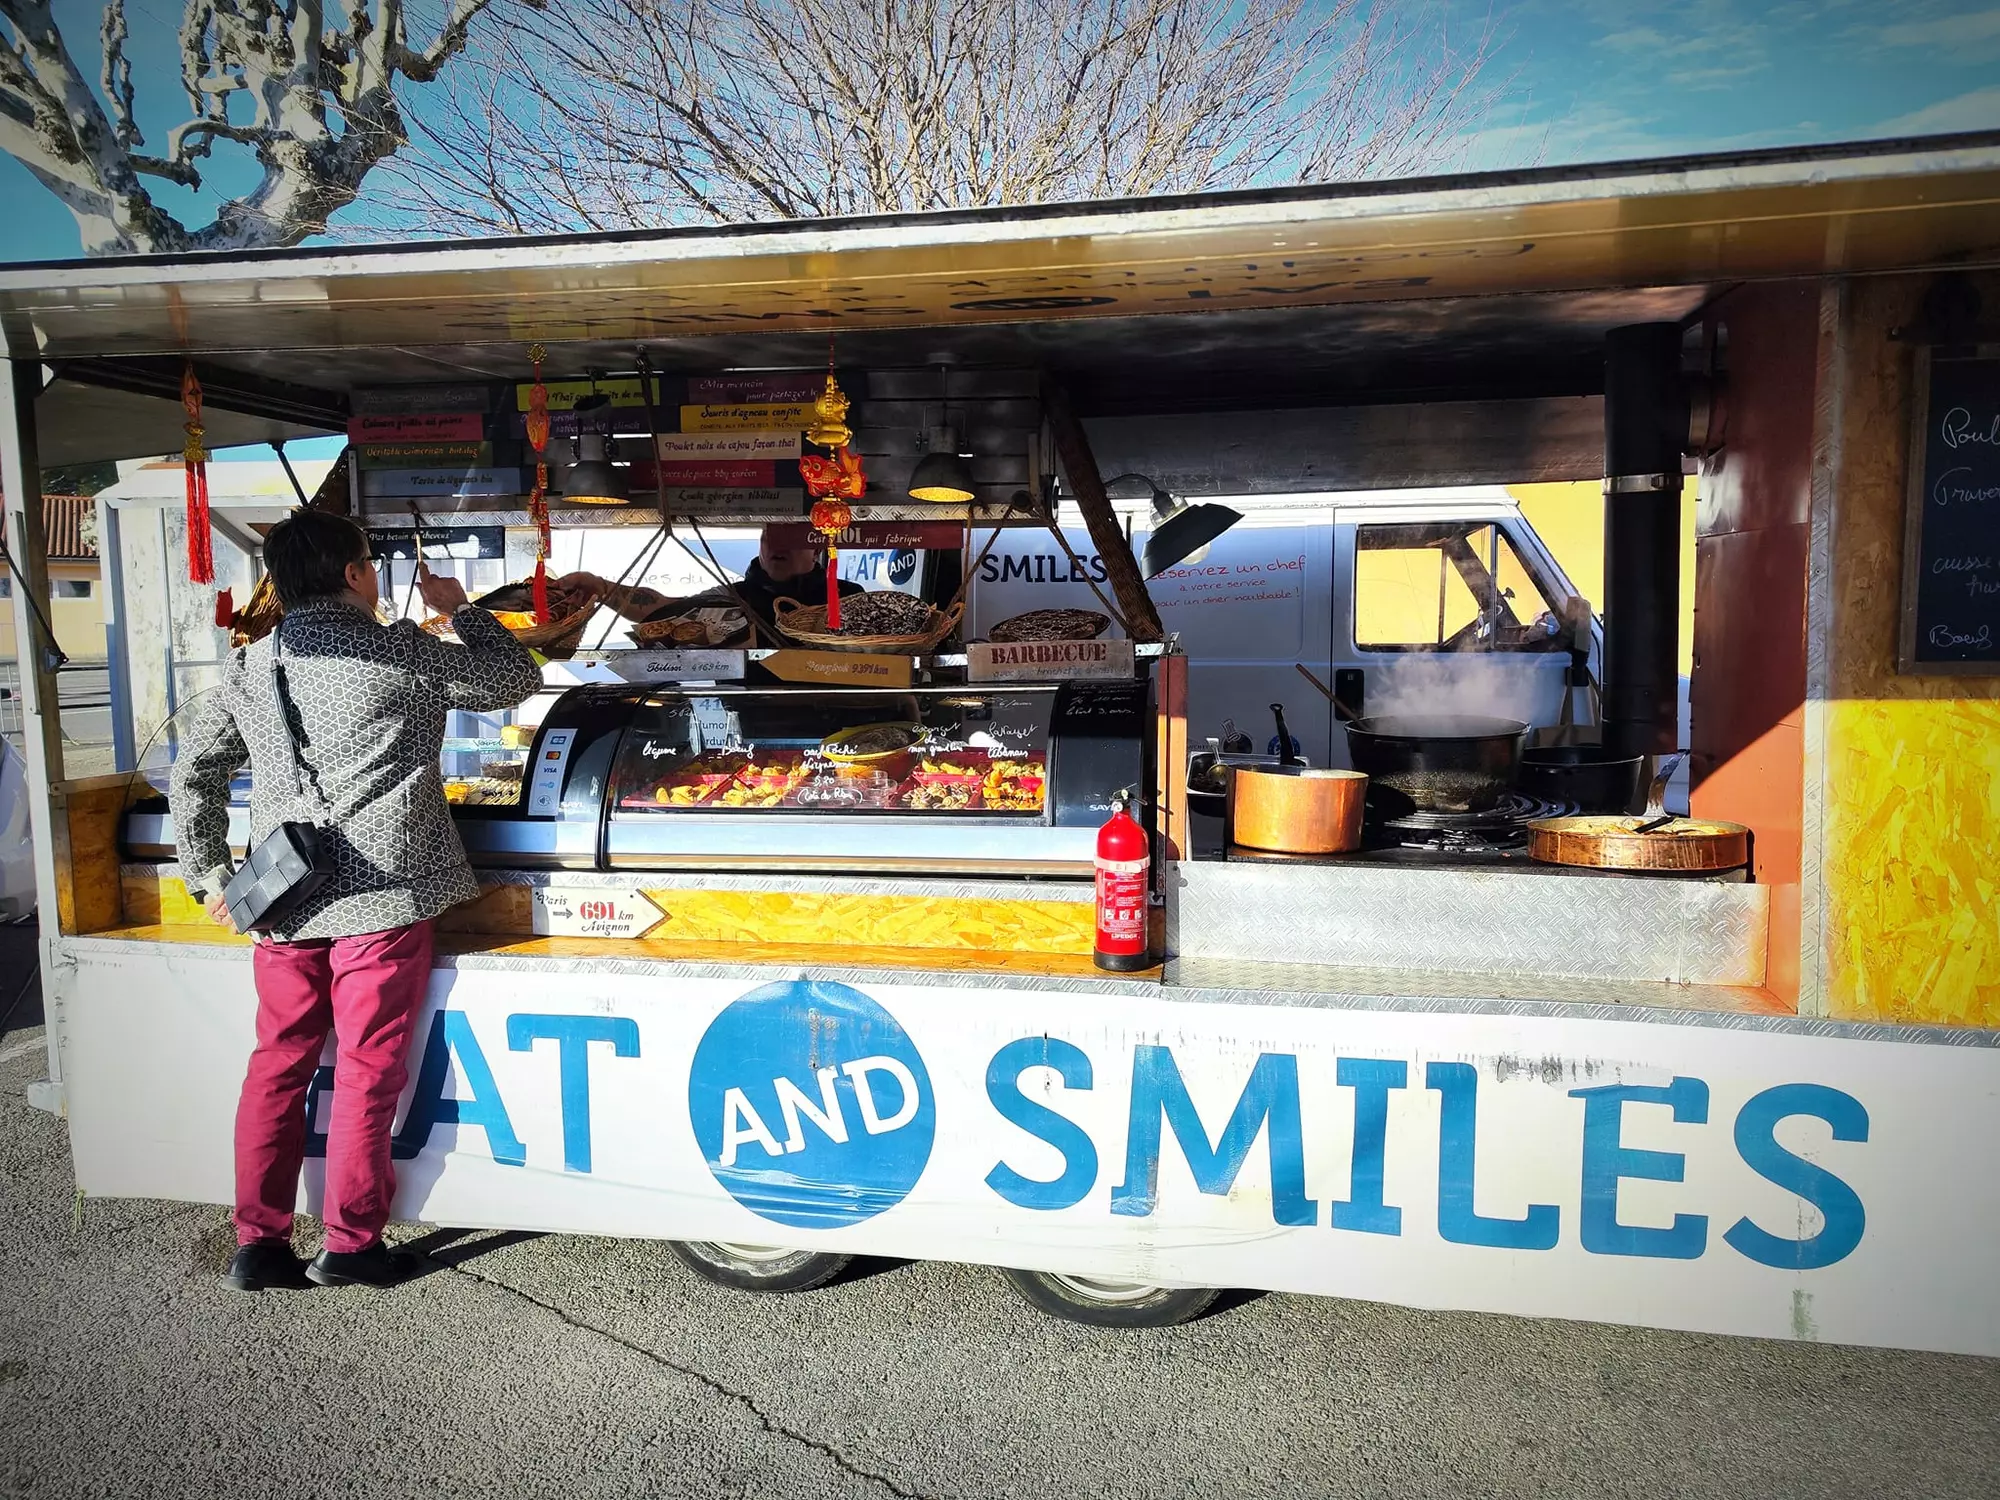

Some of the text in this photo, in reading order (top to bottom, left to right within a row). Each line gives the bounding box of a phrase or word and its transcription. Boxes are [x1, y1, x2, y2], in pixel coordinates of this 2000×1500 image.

[701, 406, 802, 420] Souris d'agneau confite
[665, 439, 695, 452] Poulet
[728, 439, 750, 452] cajou
[883, 533, 925, 547] fabrique
[889, 553, 915, 577] AND
[979, 553, 1108, 584] SMILES
[1236, 559, 1261, 574] un
[1266, 554, 1306, 572] chef
[1190, 580, 1222, 591] votre
[1227, 578, 1267, 588] service
[1154, 599, 1179, 609] pour
[1183, 597, 1200, 606] un
[991, 643, 1108, 665] BARBECUE
[579, 901, 634, 921] 691 km
[581, 920, 631, 937] Avignon
[719, 1054, 919, 1167] AND
[984, 1035, 1870, 1271] SMILES
